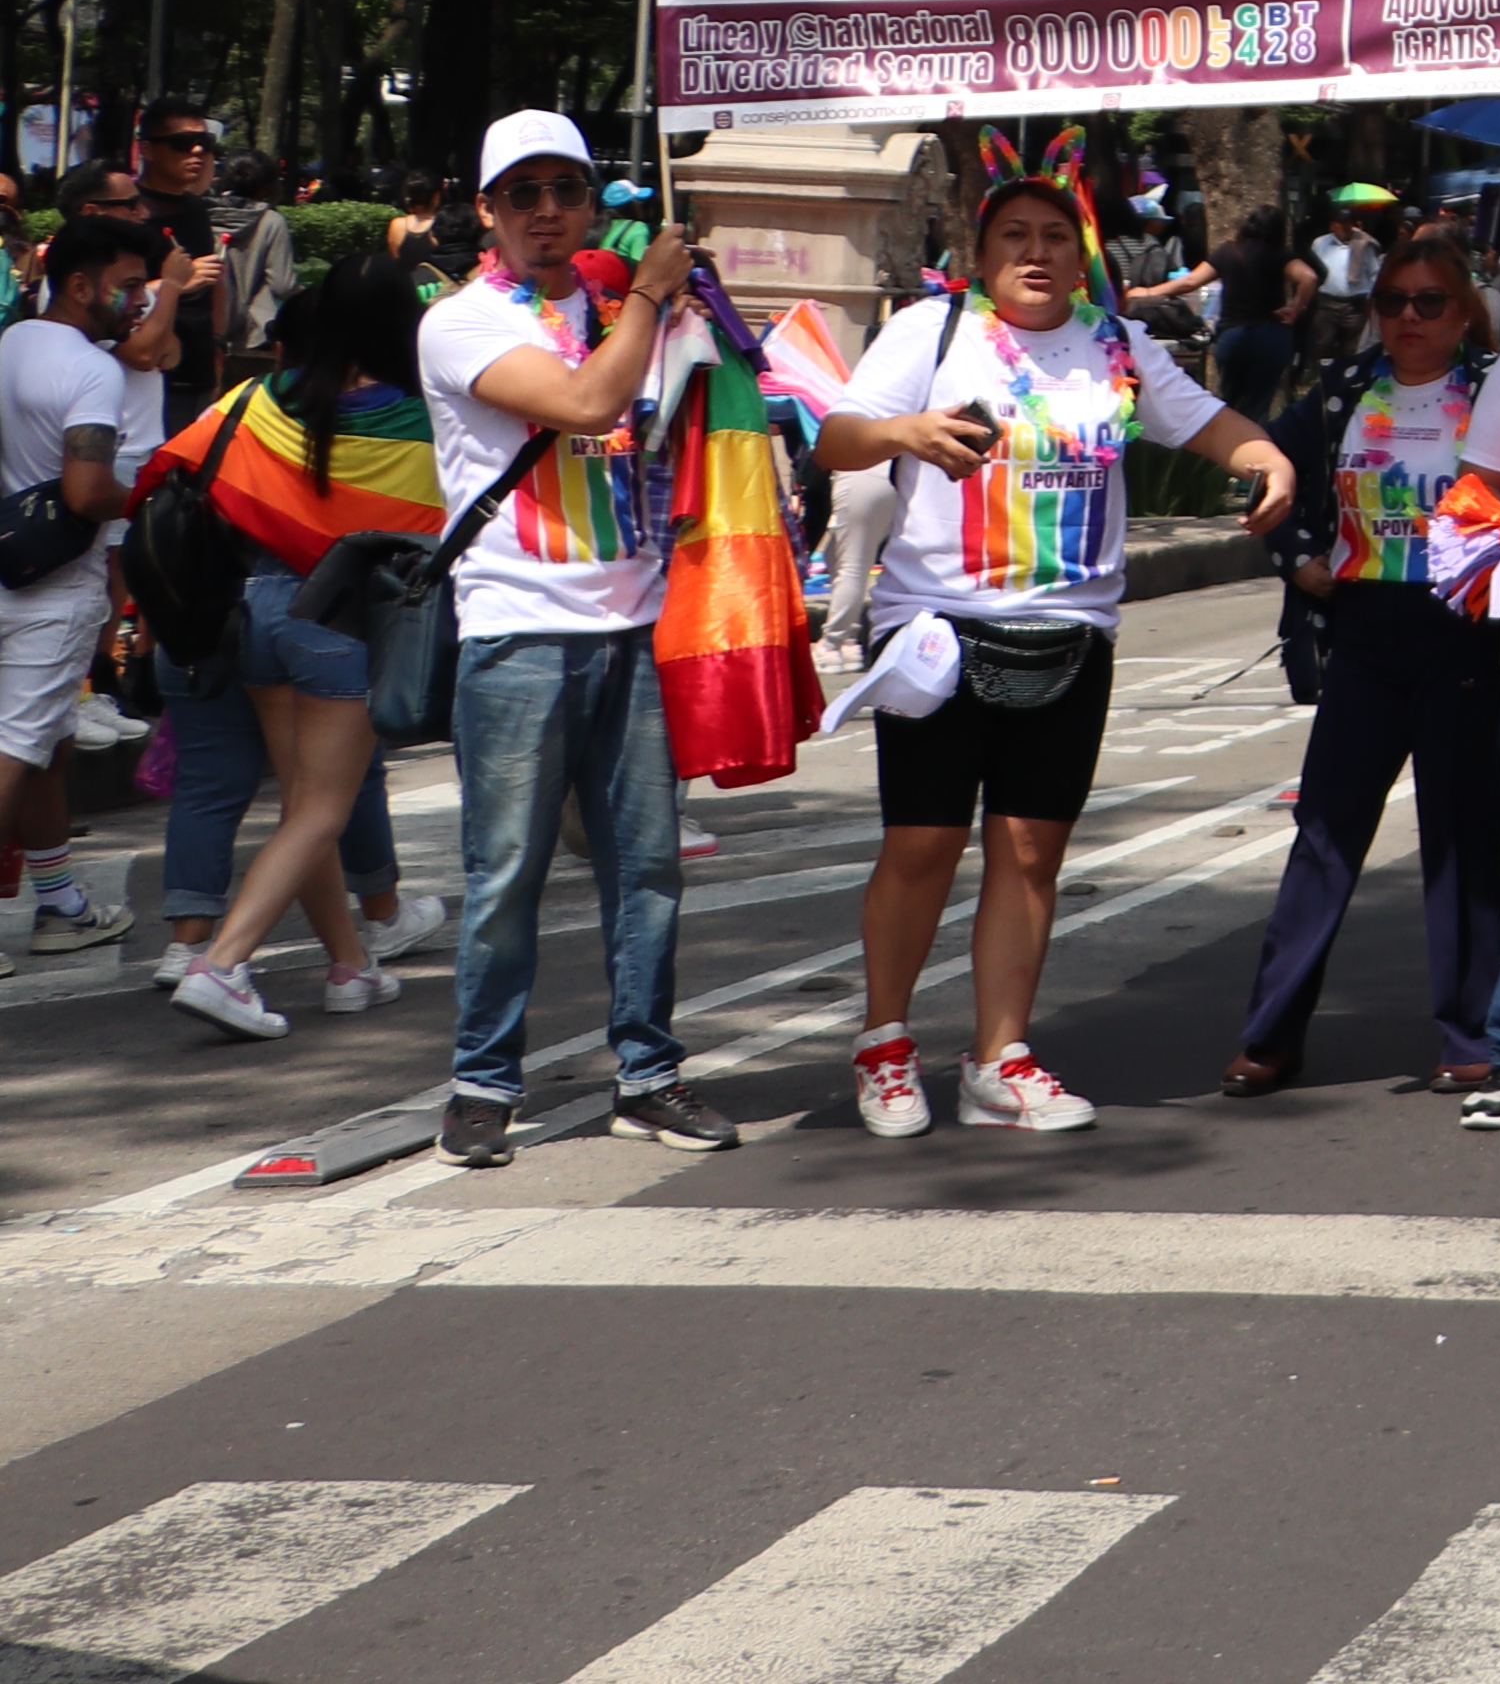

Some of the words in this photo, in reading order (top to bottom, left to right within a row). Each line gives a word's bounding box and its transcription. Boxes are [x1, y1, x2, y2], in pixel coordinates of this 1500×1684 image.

[680, 13, 758, 54] Línea
[761, 20, 782, 57] y
[867, 9, 994, 48] Nacional
[1207, 1, 1319, 32] LGBT
[1005, 12, 1100, 76] 800
[1106, 5, 1201, 72] 000
[1207, 28, 1317, 68] 5428
[681, 52, 866, 95] Diversidad
[874, 51, 994, 89] Segura
[1022, 470, 1104, 489] APOYARTE
